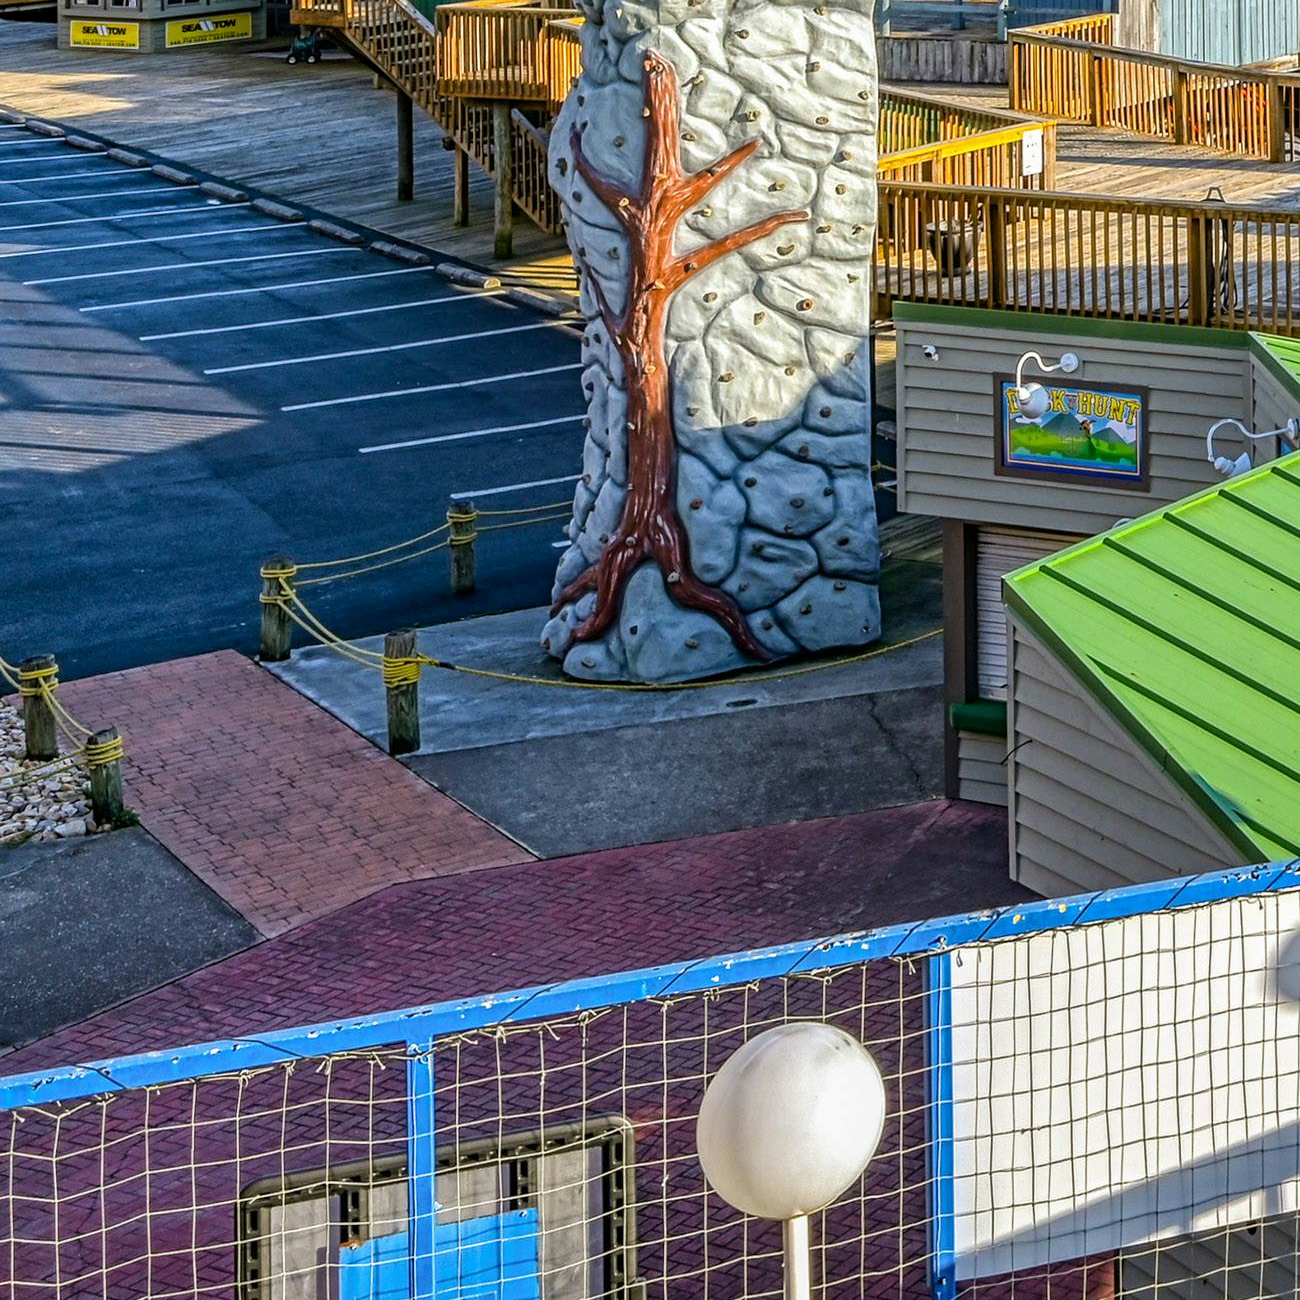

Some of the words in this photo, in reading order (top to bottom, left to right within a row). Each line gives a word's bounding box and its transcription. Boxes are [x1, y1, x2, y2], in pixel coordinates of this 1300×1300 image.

[82, 26, 98, 34] SEA
[108, 27, 126, 35] TOW
[182, 23, 201, 32] SEA
[213, 19, 236, 29] TOW
[1006, 388, 1066, 413] DK
[1076, 391, 1140, 425] HUNT
